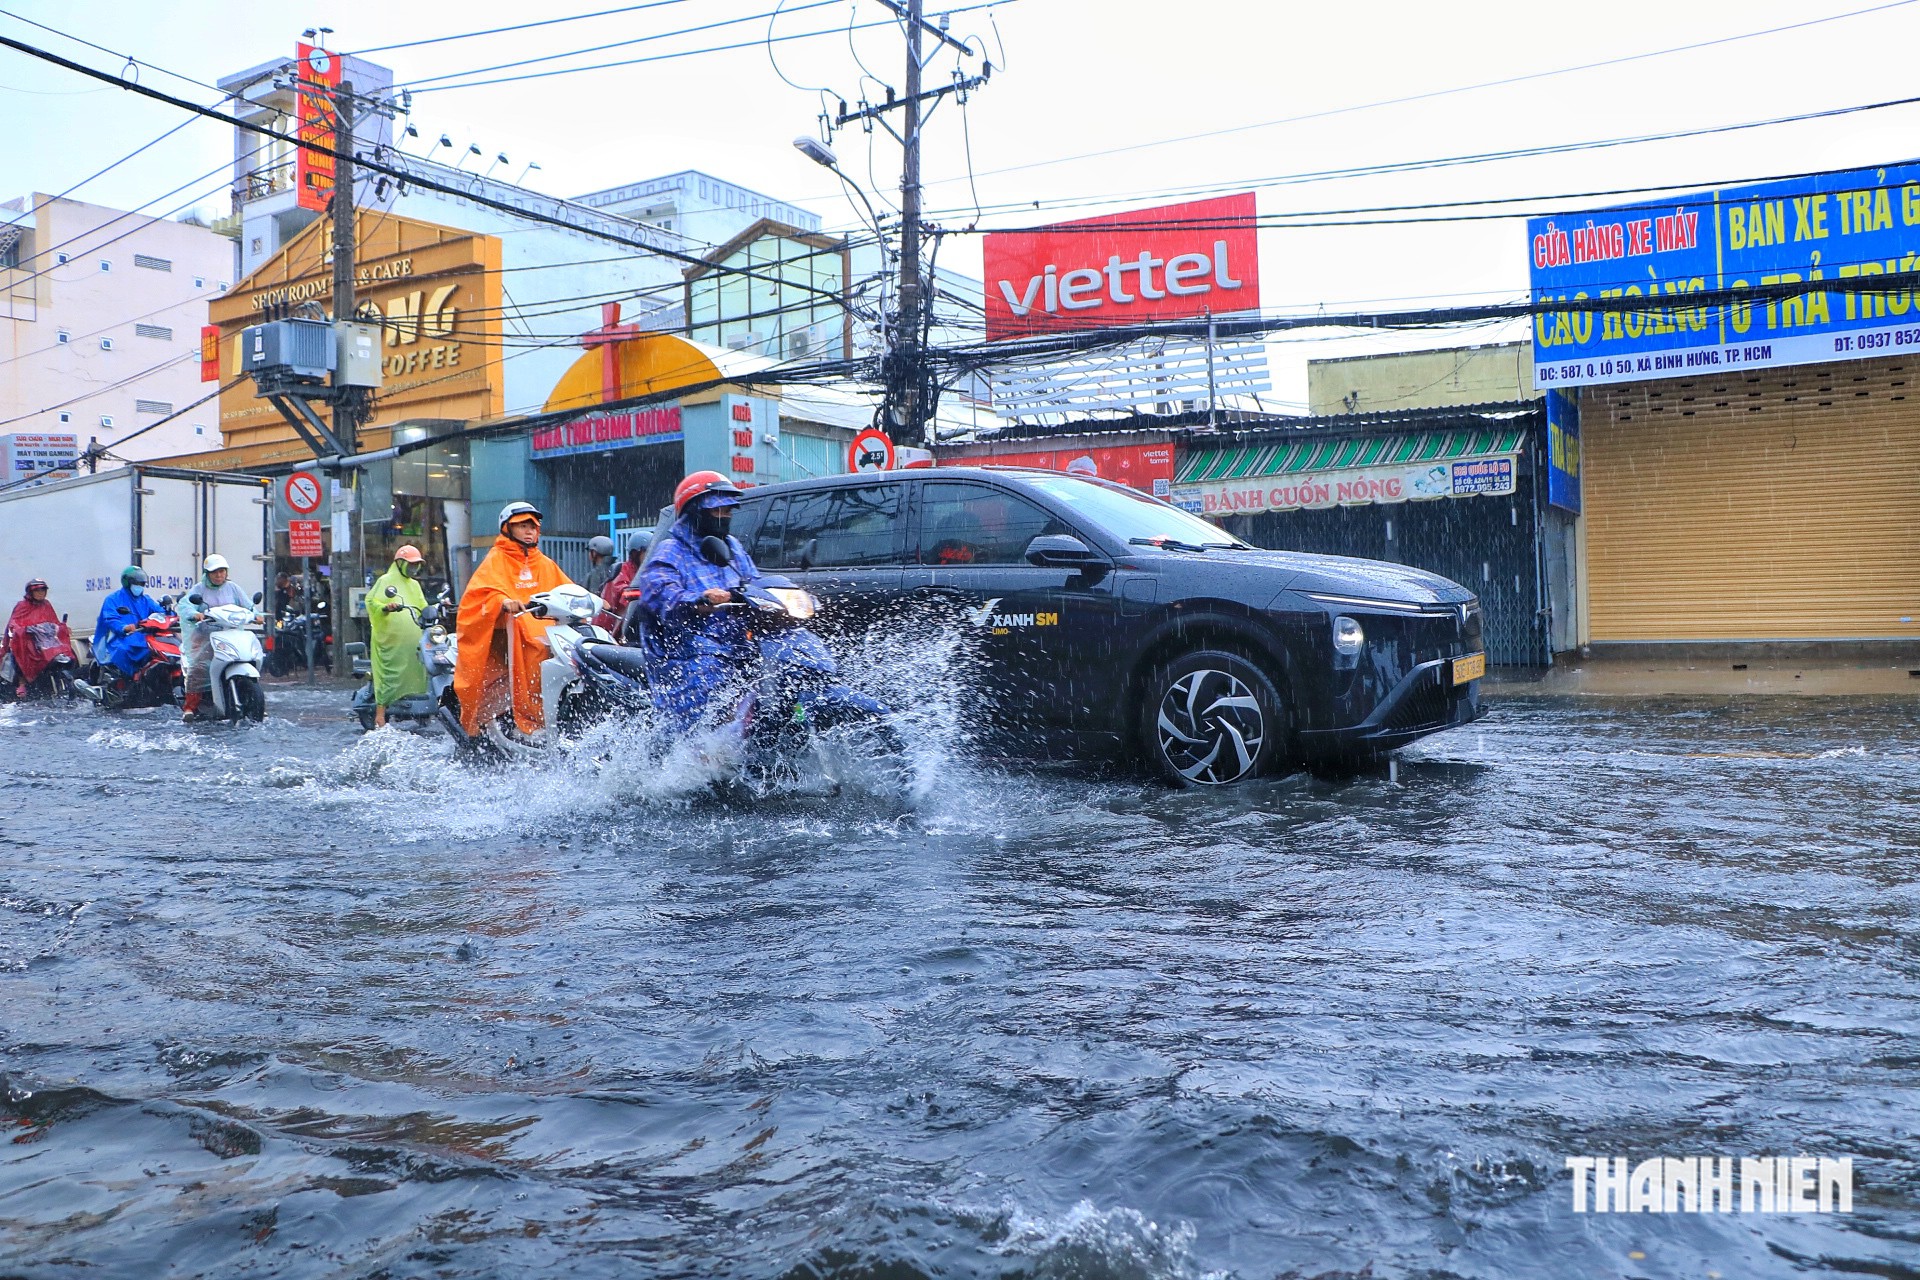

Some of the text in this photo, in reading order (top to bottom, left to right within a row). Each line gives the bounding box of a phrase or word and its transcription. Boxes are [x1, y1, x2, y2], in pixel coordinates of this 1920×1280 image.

[1729, 195, 1785, 250] BÁN
[1793, 194, 1829, 243] XE
[1837, 168, 1893, 236] TRẢ
[1534, 207, 1699, 269] CỬA HÀNG XE MÁY
[373, 258, 412, 283] CAFE
[998, 239, 1243, 317] viettel
[1535, 265, 1708, 348] CAO HOÀNG
[1761, 250, 1831, 330] TRẢ
[1834, 336, 1854, 352] ĐT:
[1857, 332, 1891, 350] 0937
[1540, 345, 1772, 381] ĐC: 587, Q. LỘ 50, XÃ BÌNH HƯNG, TP. HCM
[1142, 449, 1170, 457] viettel
[1468, 461, 1489, 476] QUỐC
[1489, 461, 1499, 475] LỘ
[1499, 462, 1510, 473] 50
[1203, 487, 1264, 512] BÁNH
[1269, 477, 1330, 506] CUỐN
[1336, 475, 1401, 501] NÓNG
[992, 612, 1058, 627] XANH SM
